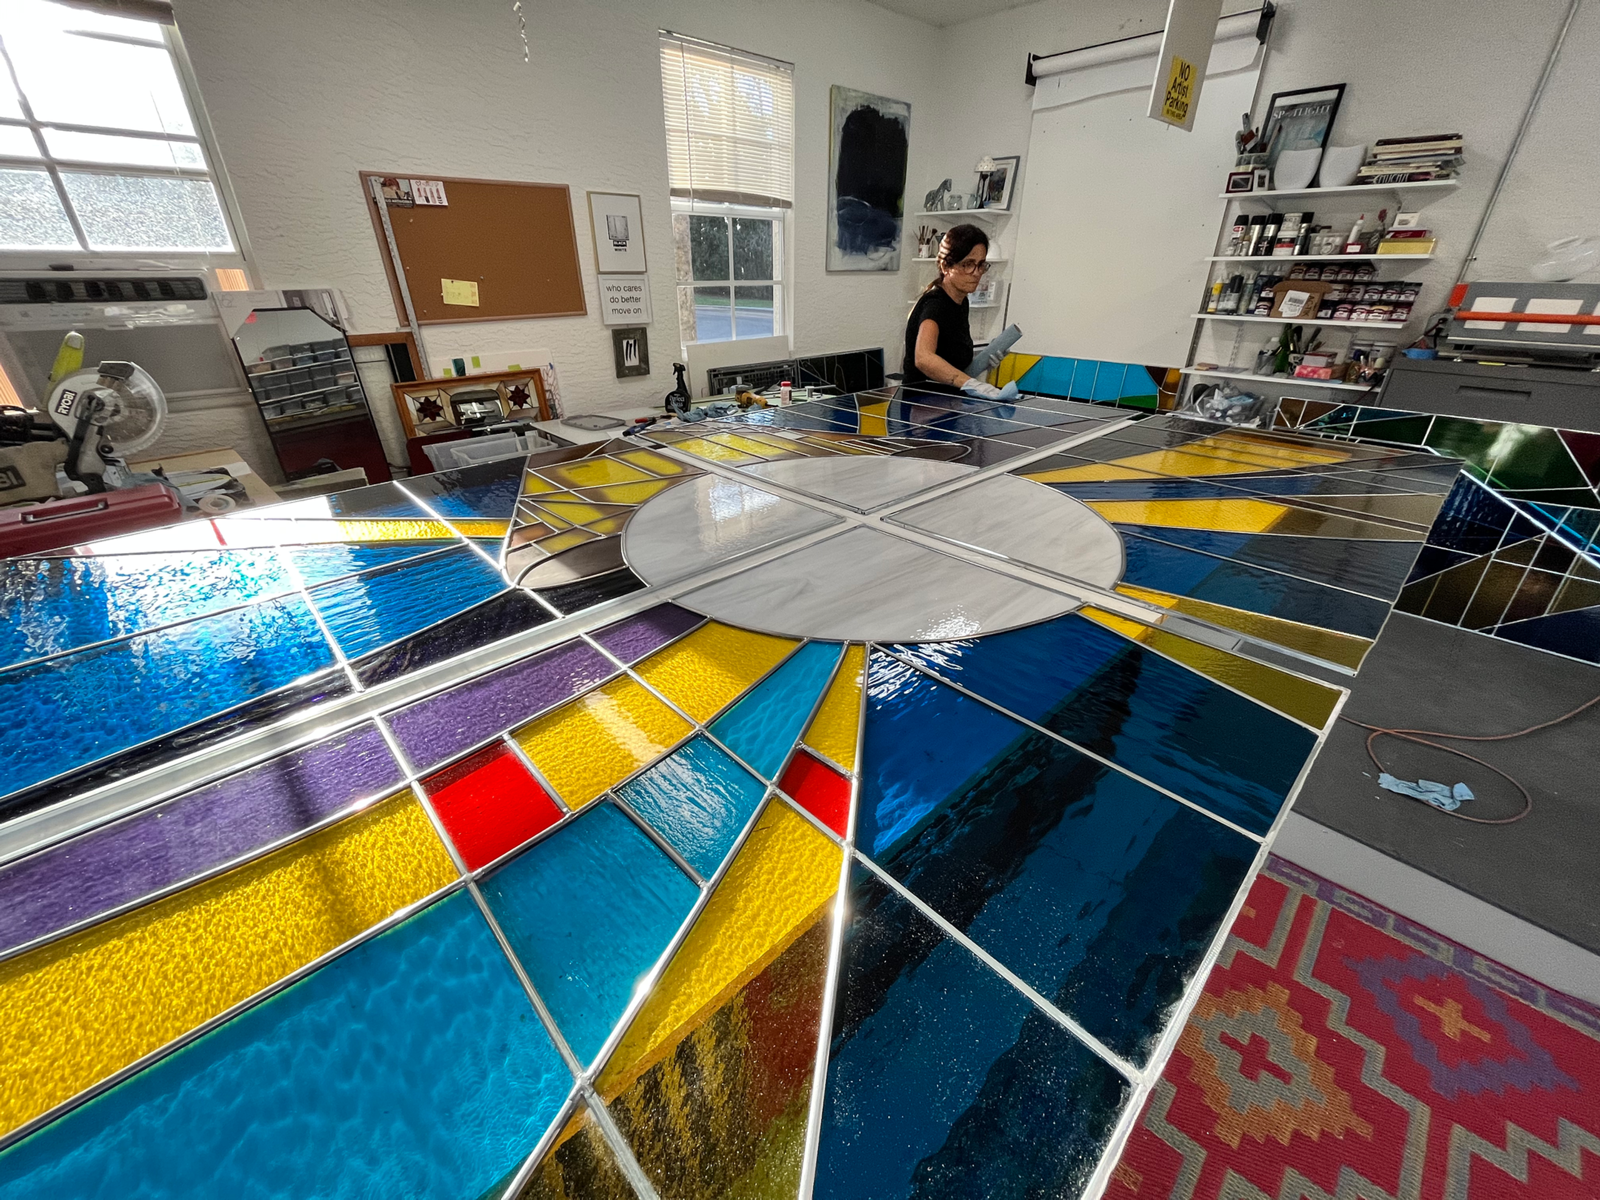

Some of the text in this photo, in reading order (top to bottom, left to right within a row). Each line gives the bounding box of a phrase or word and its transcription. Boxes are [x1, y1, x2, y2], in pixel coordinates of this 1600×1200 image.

[1179, 61, 1190, 81] NO
[1171, 76, 1189, 98] Artist
[1165, 91, 1189, 117] Parking
[606, 284, 622, 292] who
[609, 295, 642, 303] do better
[611, 307, 632, 315] move
[57, 391, 75, 414] RYOBI
